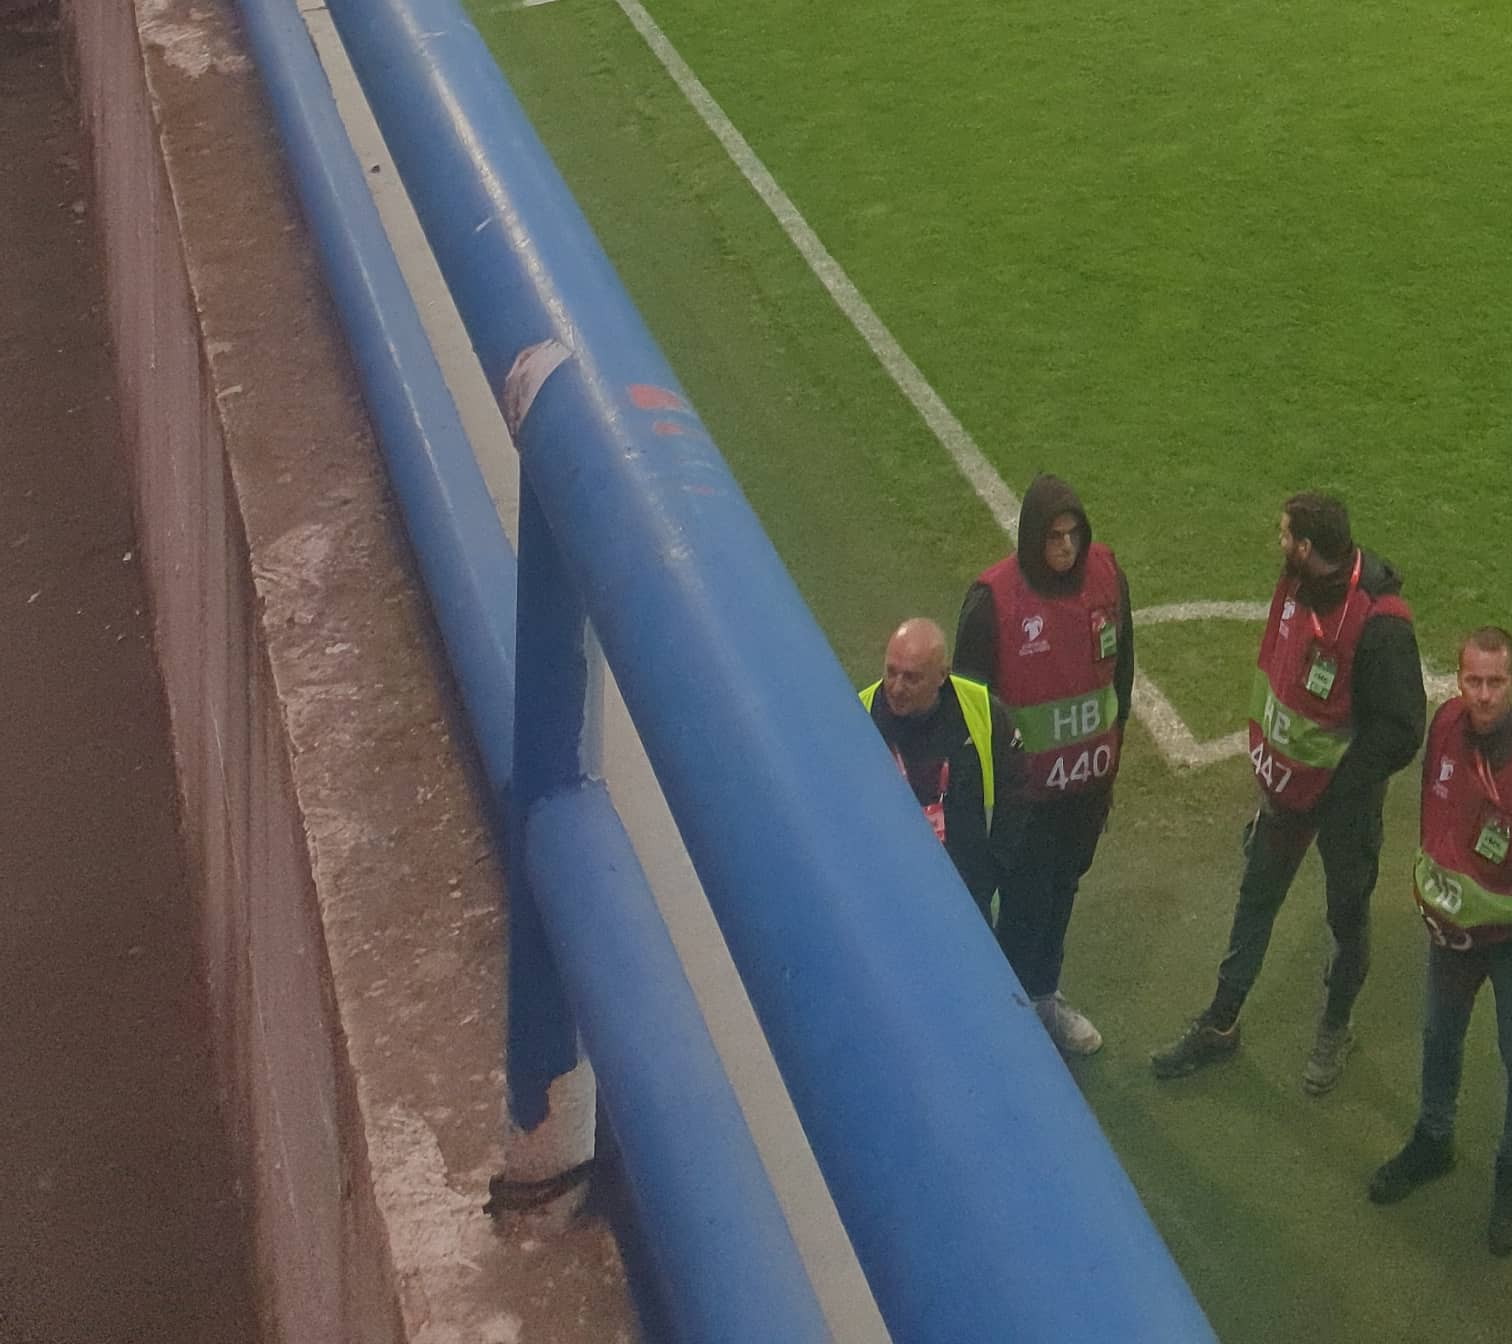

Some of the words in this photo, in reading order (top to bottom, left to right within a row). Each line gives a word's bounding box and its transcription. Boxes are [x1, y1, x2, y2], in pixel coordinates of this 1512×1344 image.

[1053, 699, 1101, 740] HB
[1045, 744, 1111, 790] 440
[1250, 743, 1293, 793] 447
